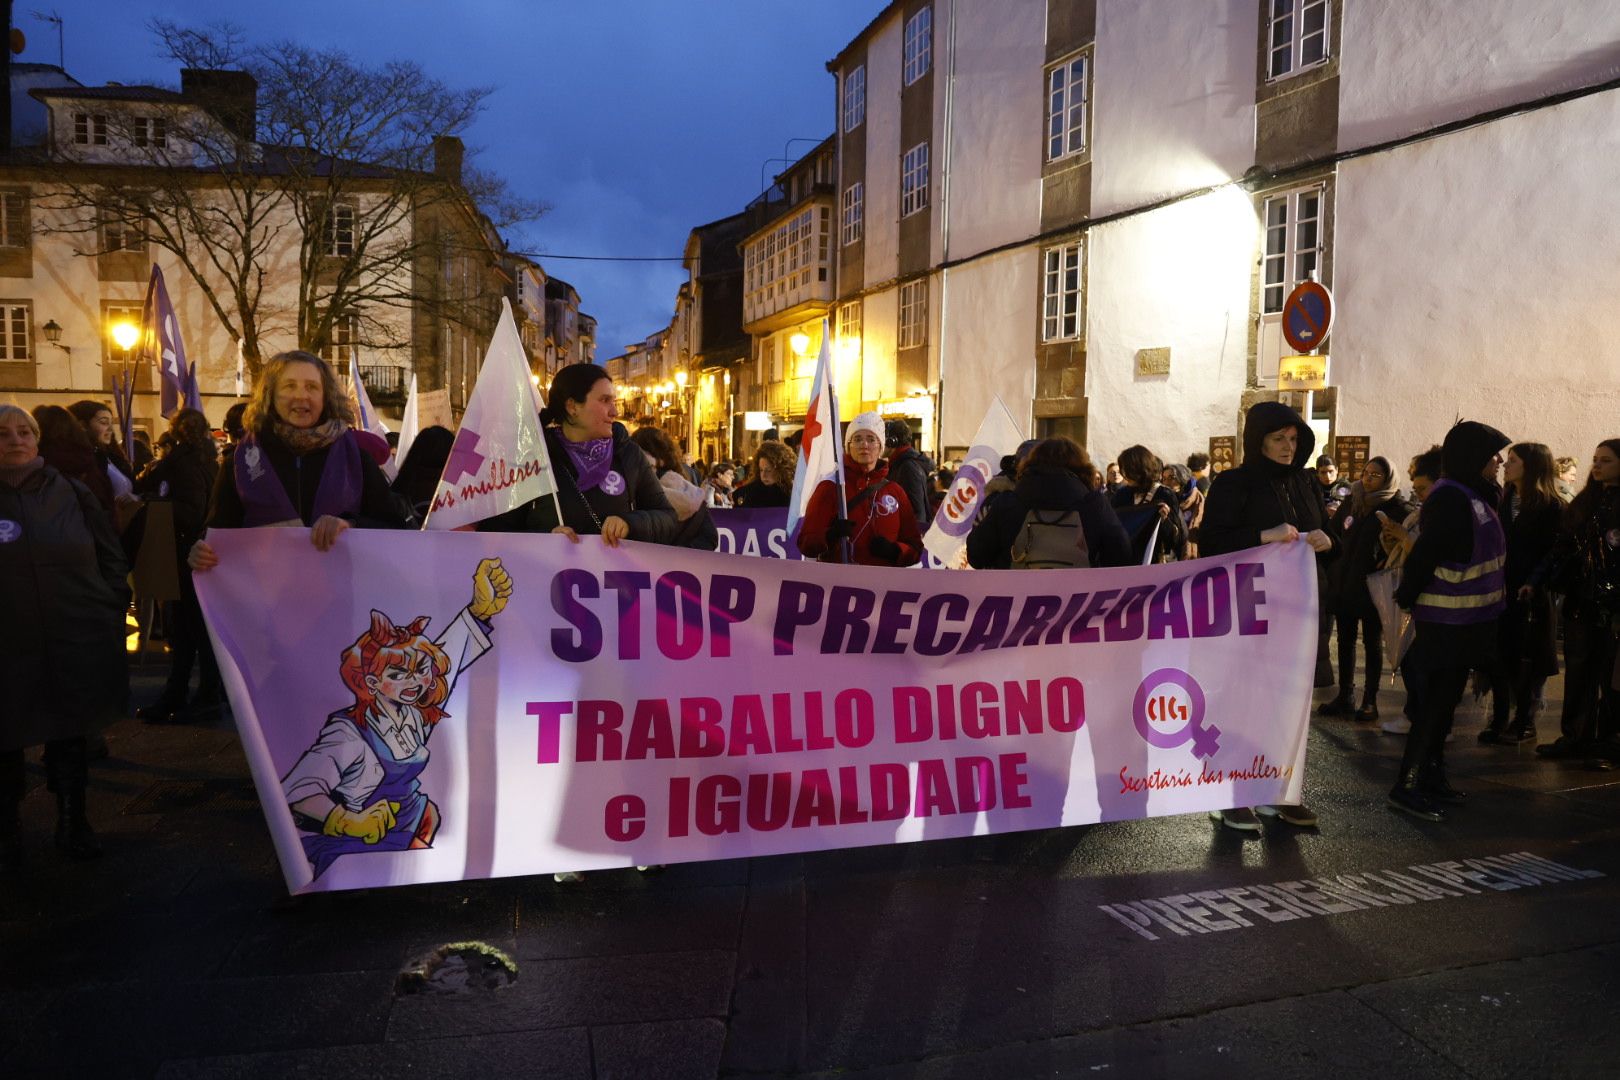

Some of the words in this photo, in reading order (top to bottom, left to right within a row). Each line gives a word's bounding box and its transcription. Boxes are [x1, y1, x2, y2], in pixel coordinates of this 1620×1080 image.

[460, 459, 542, 500] mulleres
[946, 486, 977, 519] CIG
[550, 568, 756, 663] STOP
[773, 562, 1269, 657] PRECARIEDADE
[525, 688, 875, 765] TRABALLO
[892, 676, 1086, 744] DIGNO
[1147, 696, 1187, 722] CIG
[604, 794, 646, 842] e
[668, 752, 1032, 838] IGUALDADE
[1119, 765, 1193, 795] Secretaría
[1197, 760, 1223, 786] das
[1097, 868, 1465, 941] PREFERENCIA
